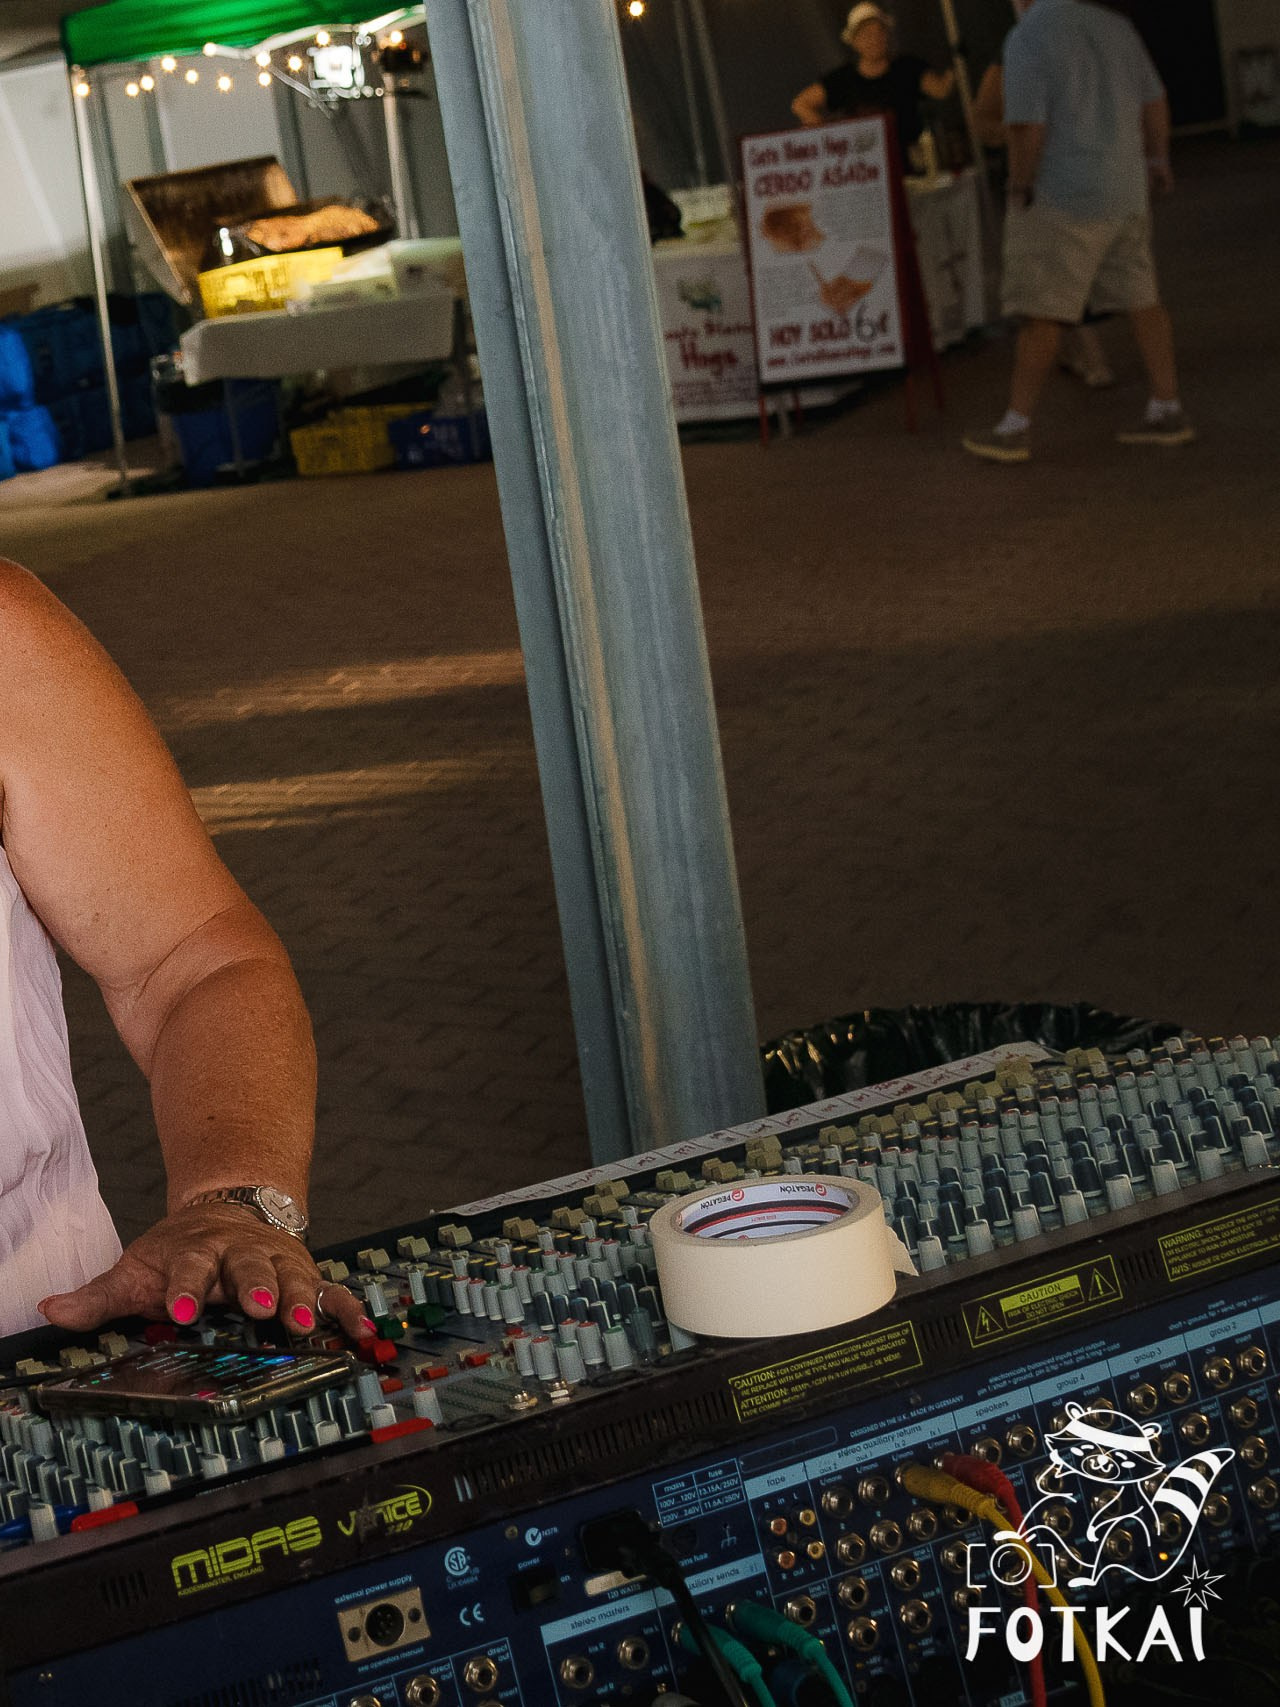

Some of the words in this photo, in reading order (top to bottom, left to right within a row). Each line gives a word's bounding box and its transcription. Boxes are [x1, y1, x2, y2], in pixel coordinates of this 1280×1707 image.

[753, 167, 811, 197] CERDO
[769, 324, 802, 347] HOY
[700, 1194, 730, 1209] PEGATÓN
[1162, 1229, 1202, 1249] WARNING:
[1019, 1282, 1060, 1303] CAUTION
[1024, 1310, 1035, 1318] DO
[1035, 1305, 1049, 1315] NOT
[1050, 1300, 1065, 1310] OPEN
[1209, 1324, 1231, 1338] group
[1134, 1350, 1155, 1364] group
[1156, 1347, 1160, 1355] 3
[734, 1369, 774, 1389] CAUTION:
[751, 1379, 777, 1393] REPLACE
[778, 1373, 793, 1384] WITH
[1057, 1375, 1079, 1390] group
[1080, 1373, 1084, 1381] 4
[740, 1386, 789, 1409] ATTENTION:
[975, 1399, 1008, 1417] speakers
[850, 1423, 877, 1438] DESIGNED
[837, 1444, 861, 1458] stereo
[862, 1432, 895, 1450] auxiliary
[896, 1423, 921, 1439] returns
[708, 1467, 722, 1478] fuse
[767, 1475, 785, 1488] tape
[681, 1491, 696, 1501] 120V
[764, 1501, 769, 1509] R
[171, 1515, 323, 1588] MIDAS
[517, 1557, 540, 1570] power
[234, 1564, 264, 1580] ENGLAND
[560, 1573, 570, 1582] on
[717, 1567, 738, 1580] sends
[793, 1567, 804, 1577] out
[334, 1588, 364, 1604] external
[366, 1582, 386, 1595] power
[388, 1574, 411, 1587] supply
[608, 1589, 618, 1599] 120
[459, 1602, 483, 1627] CE
[570, 1615, 595, 1630] stereo
[597, 1603, 629, 1620] masters
[487, 1643, 507, 1656] direct
[498, 1652, 510, 1662] out
[430, 1662, 450, 1675] direct
[441, 1671, 452, 1681] out
[372, 1681, 393, 1694] direct
[382, 1690, 394, 1699] out
